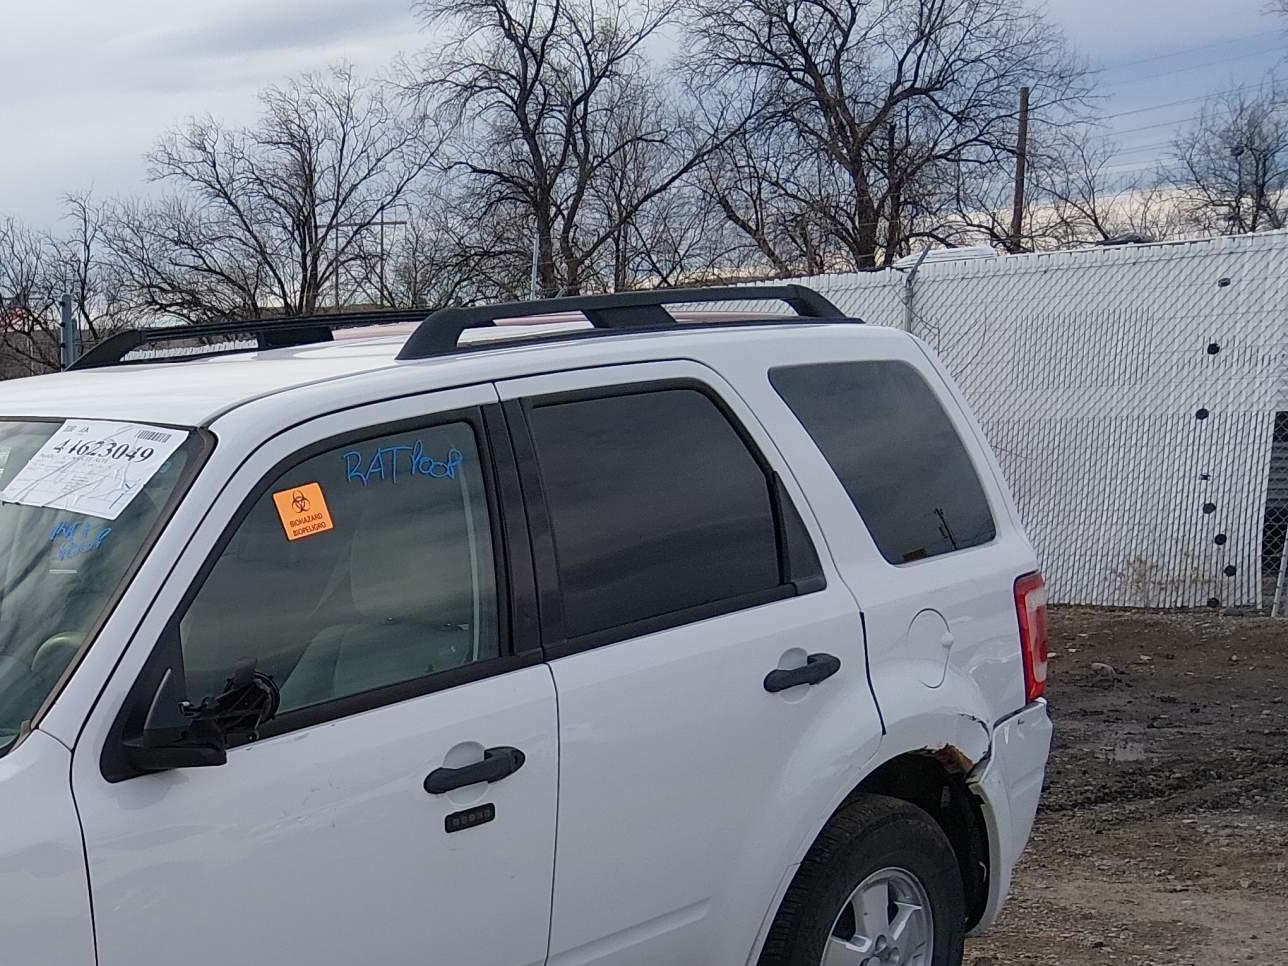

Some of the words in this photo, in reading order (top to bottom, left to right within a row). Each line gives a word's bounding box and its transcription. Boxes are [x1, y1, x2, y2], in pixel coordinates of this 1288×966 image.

[344, 446, 412, 487] RAT
[289, 512, 323, 528] BIOHAZARD
[292, 521, 327, 537] BIOPELIGRO
